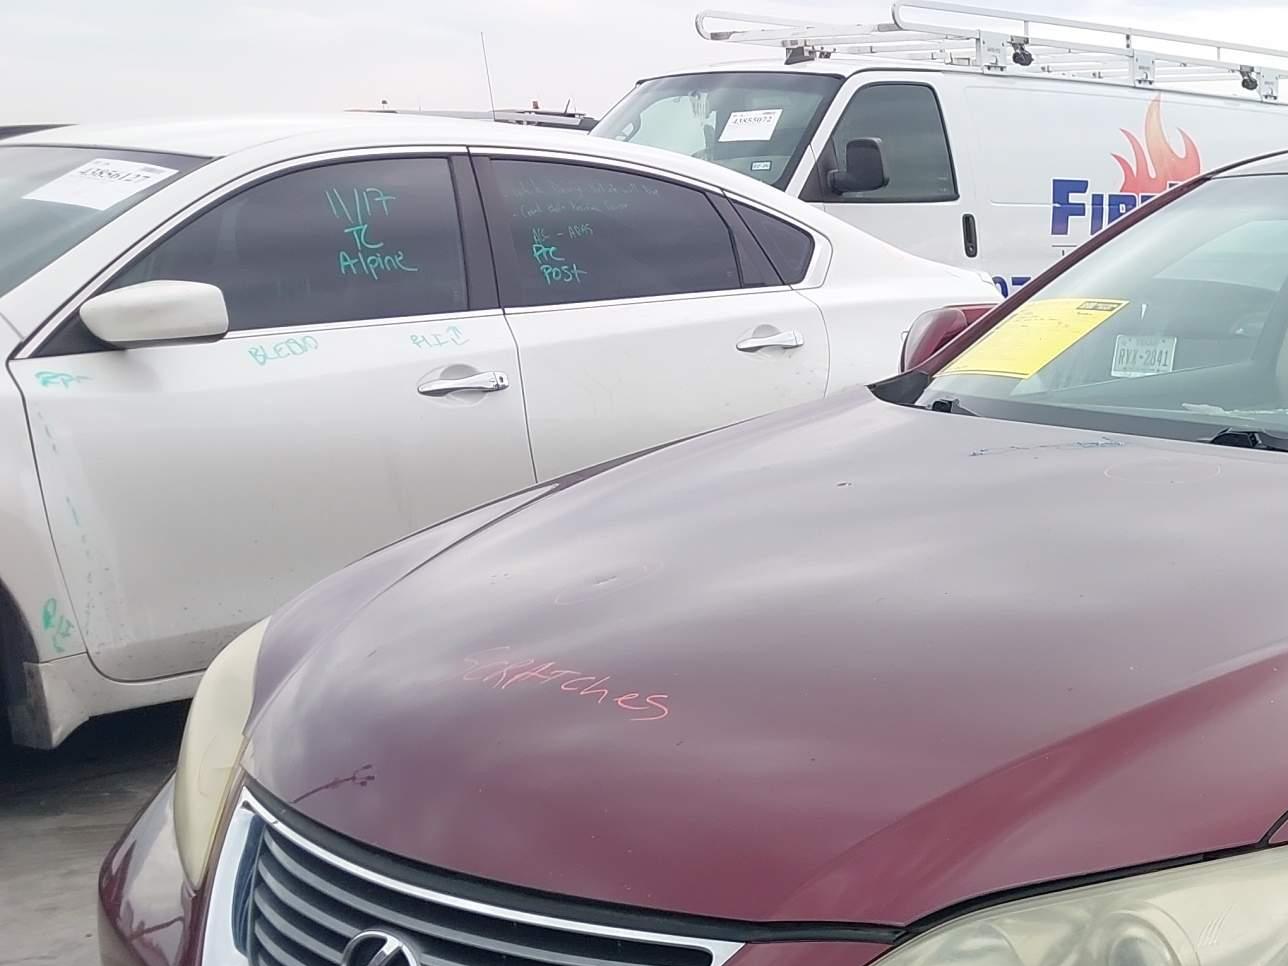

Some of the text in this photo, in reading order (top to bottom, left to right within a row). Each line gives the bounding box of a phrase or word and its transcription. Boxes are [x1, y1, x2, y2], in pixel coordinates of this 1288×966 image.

[1051, 179, 1157, 236] FIR
[344, 224, 384, 250] TC
[339, 251, 419, 280] Alpine
